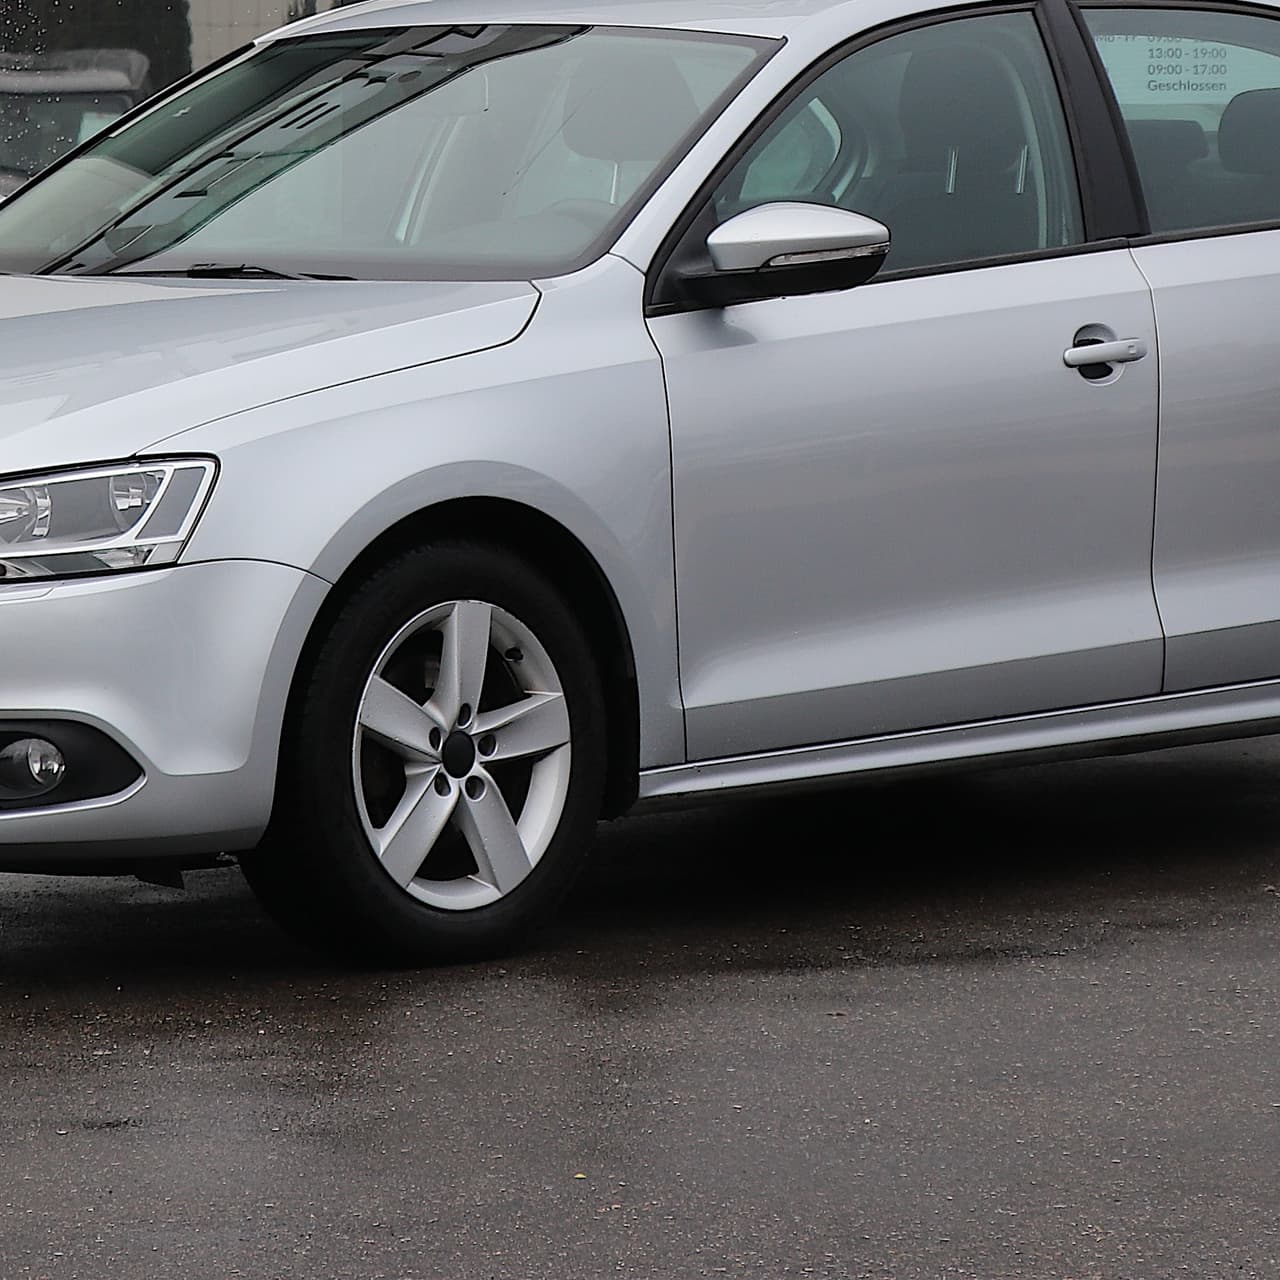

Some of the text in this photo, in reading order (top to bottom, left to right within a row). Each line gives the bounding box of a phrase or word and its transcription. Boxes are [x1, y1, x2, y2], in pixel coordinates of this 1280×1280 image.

[1148, 48, 1182, 59] 13:00
[1193, 48, 1227, 59] 19:00
[1148, 64, 1182, 75] 09:00
[1193, 64, 1227, 75] 17:00
[1147, 80, 1227, 92] Geschlossen
